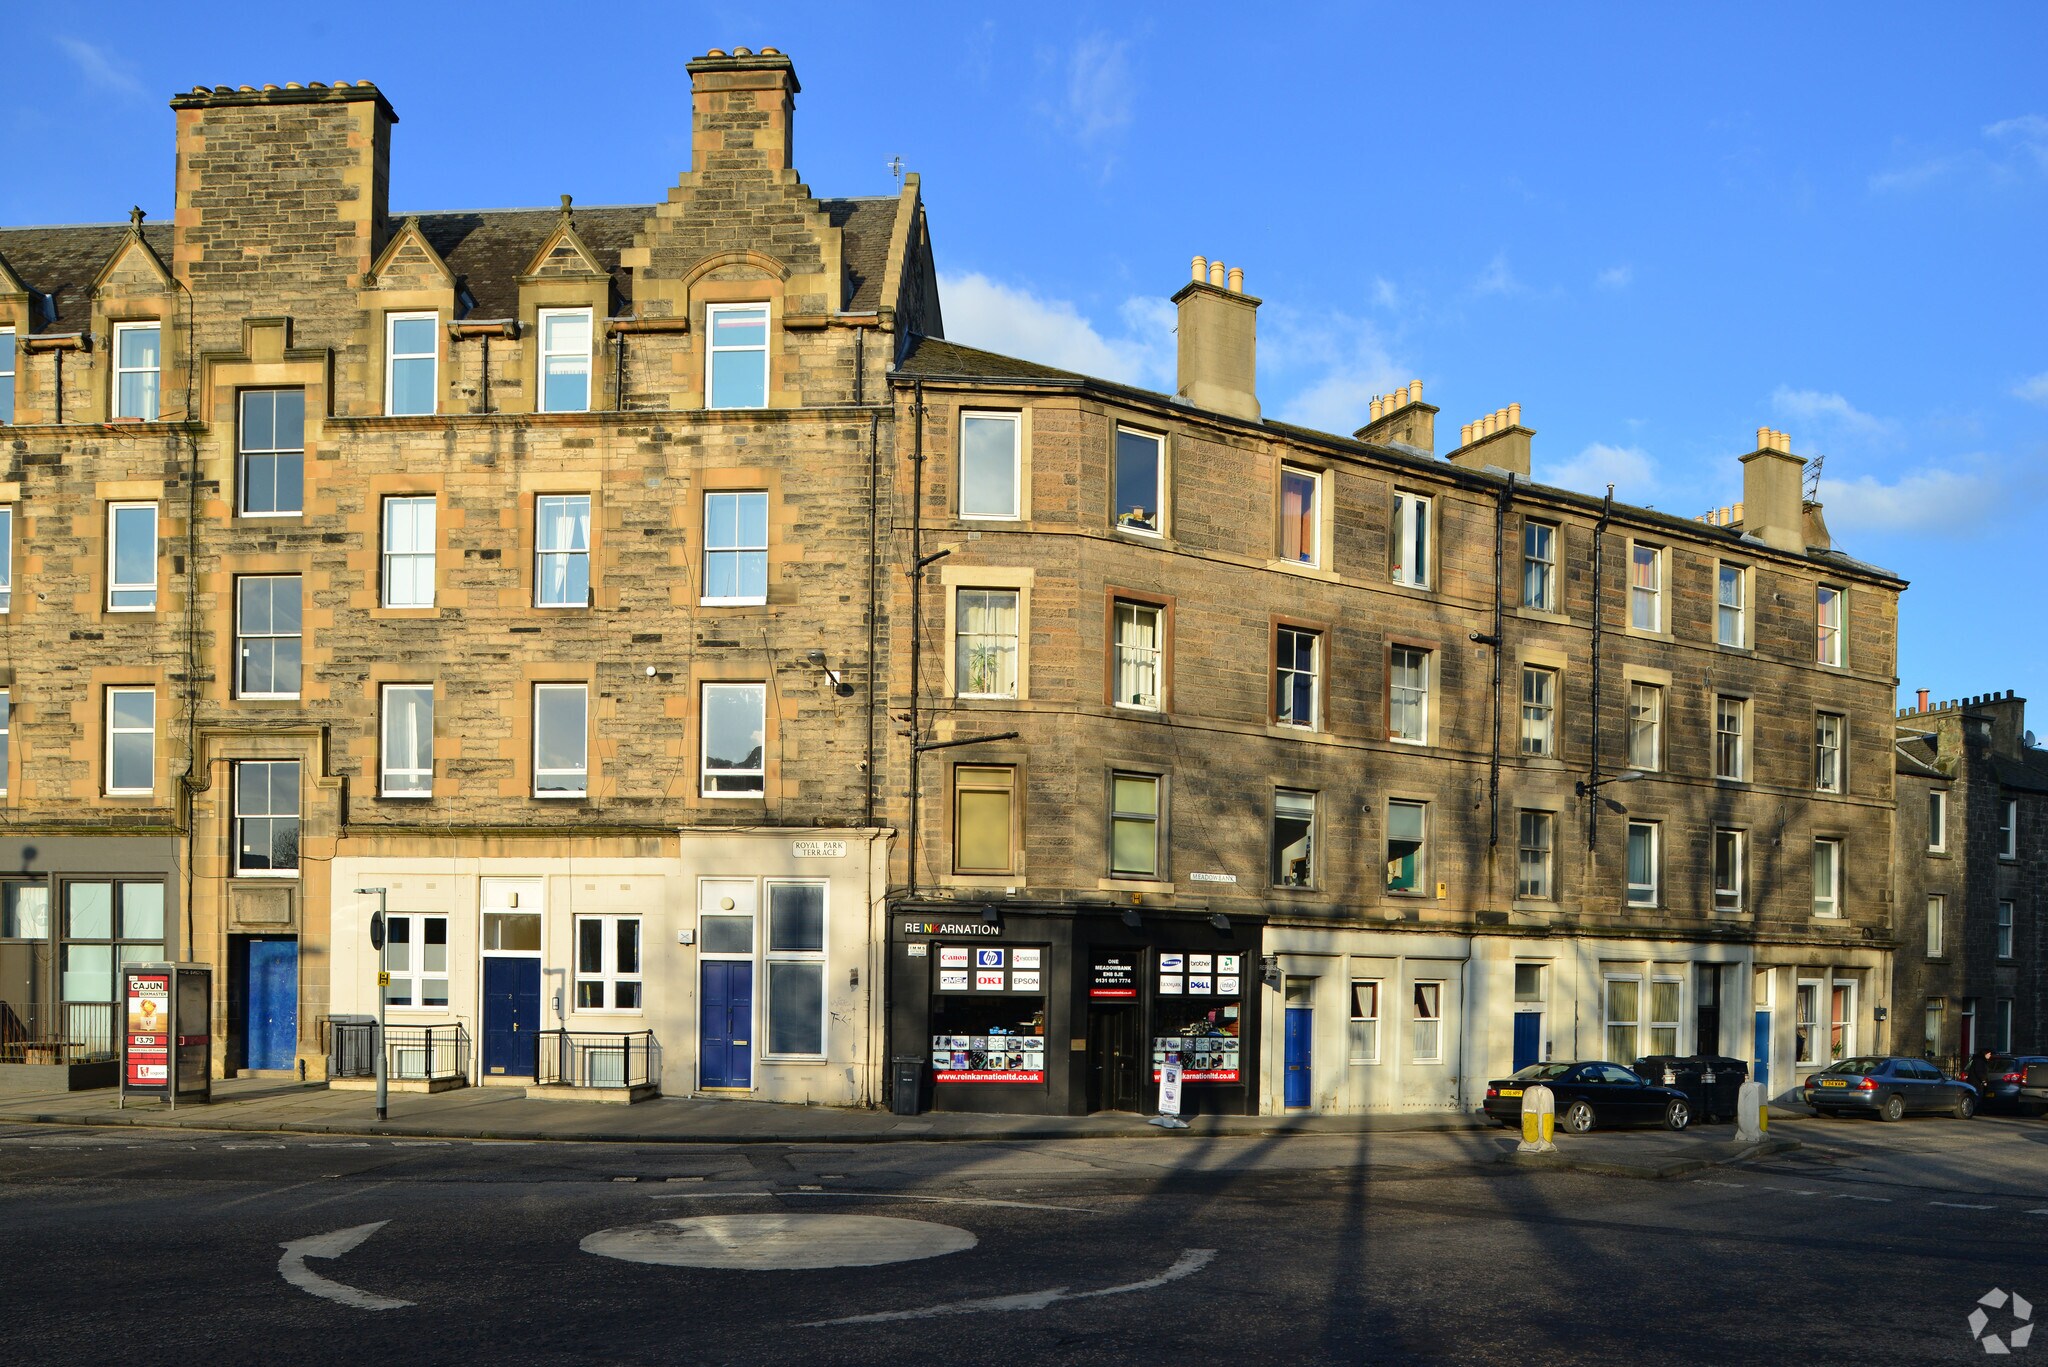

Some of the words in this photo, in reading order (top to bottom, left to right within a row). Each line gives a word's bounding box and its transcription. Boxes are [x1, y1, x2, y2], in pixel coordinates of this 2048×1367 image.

[1192, 873, 1234, 882] MEADOWBANK
[905, 922, 999, 935] REINKARNATION
[985, 950, 996, 965] hp
[977, 977, 1002, 985] OKI
[1190, 981, 1210, 989] DELL
[132, 982, 163, 990] CAJUN
[936, 1072, 1039, 1081] www.reinkarnationltd.co.uk
